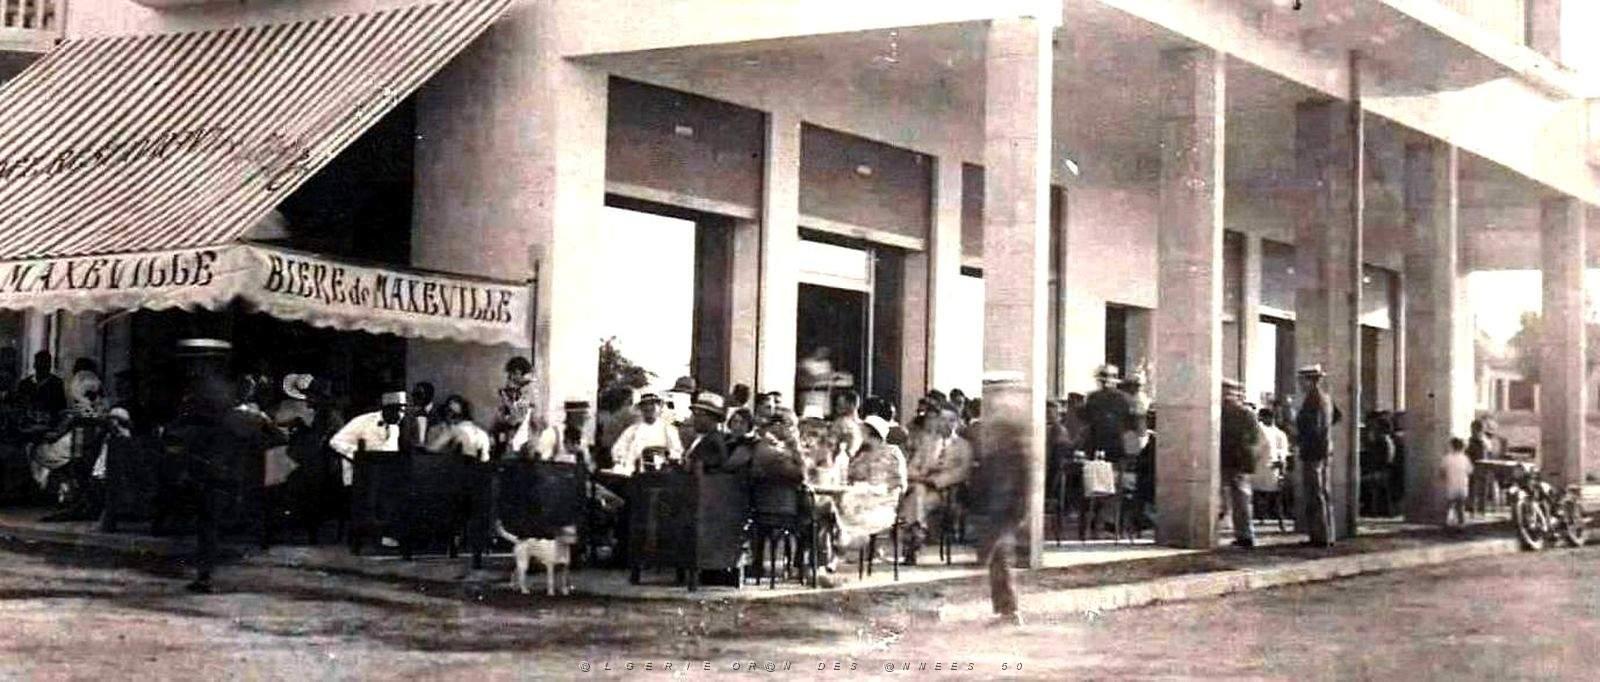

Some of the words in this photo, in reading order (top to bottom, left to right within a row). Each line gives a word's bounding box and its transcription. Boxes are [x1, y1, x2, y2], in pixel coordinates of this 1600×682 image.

[0, 250, 216, 292] MAXEVILLE
[263, 254, 346, 305] BIERE
[349, 276, 370, 305] de
[373, 273, 512, 323] MAXEVILLE
